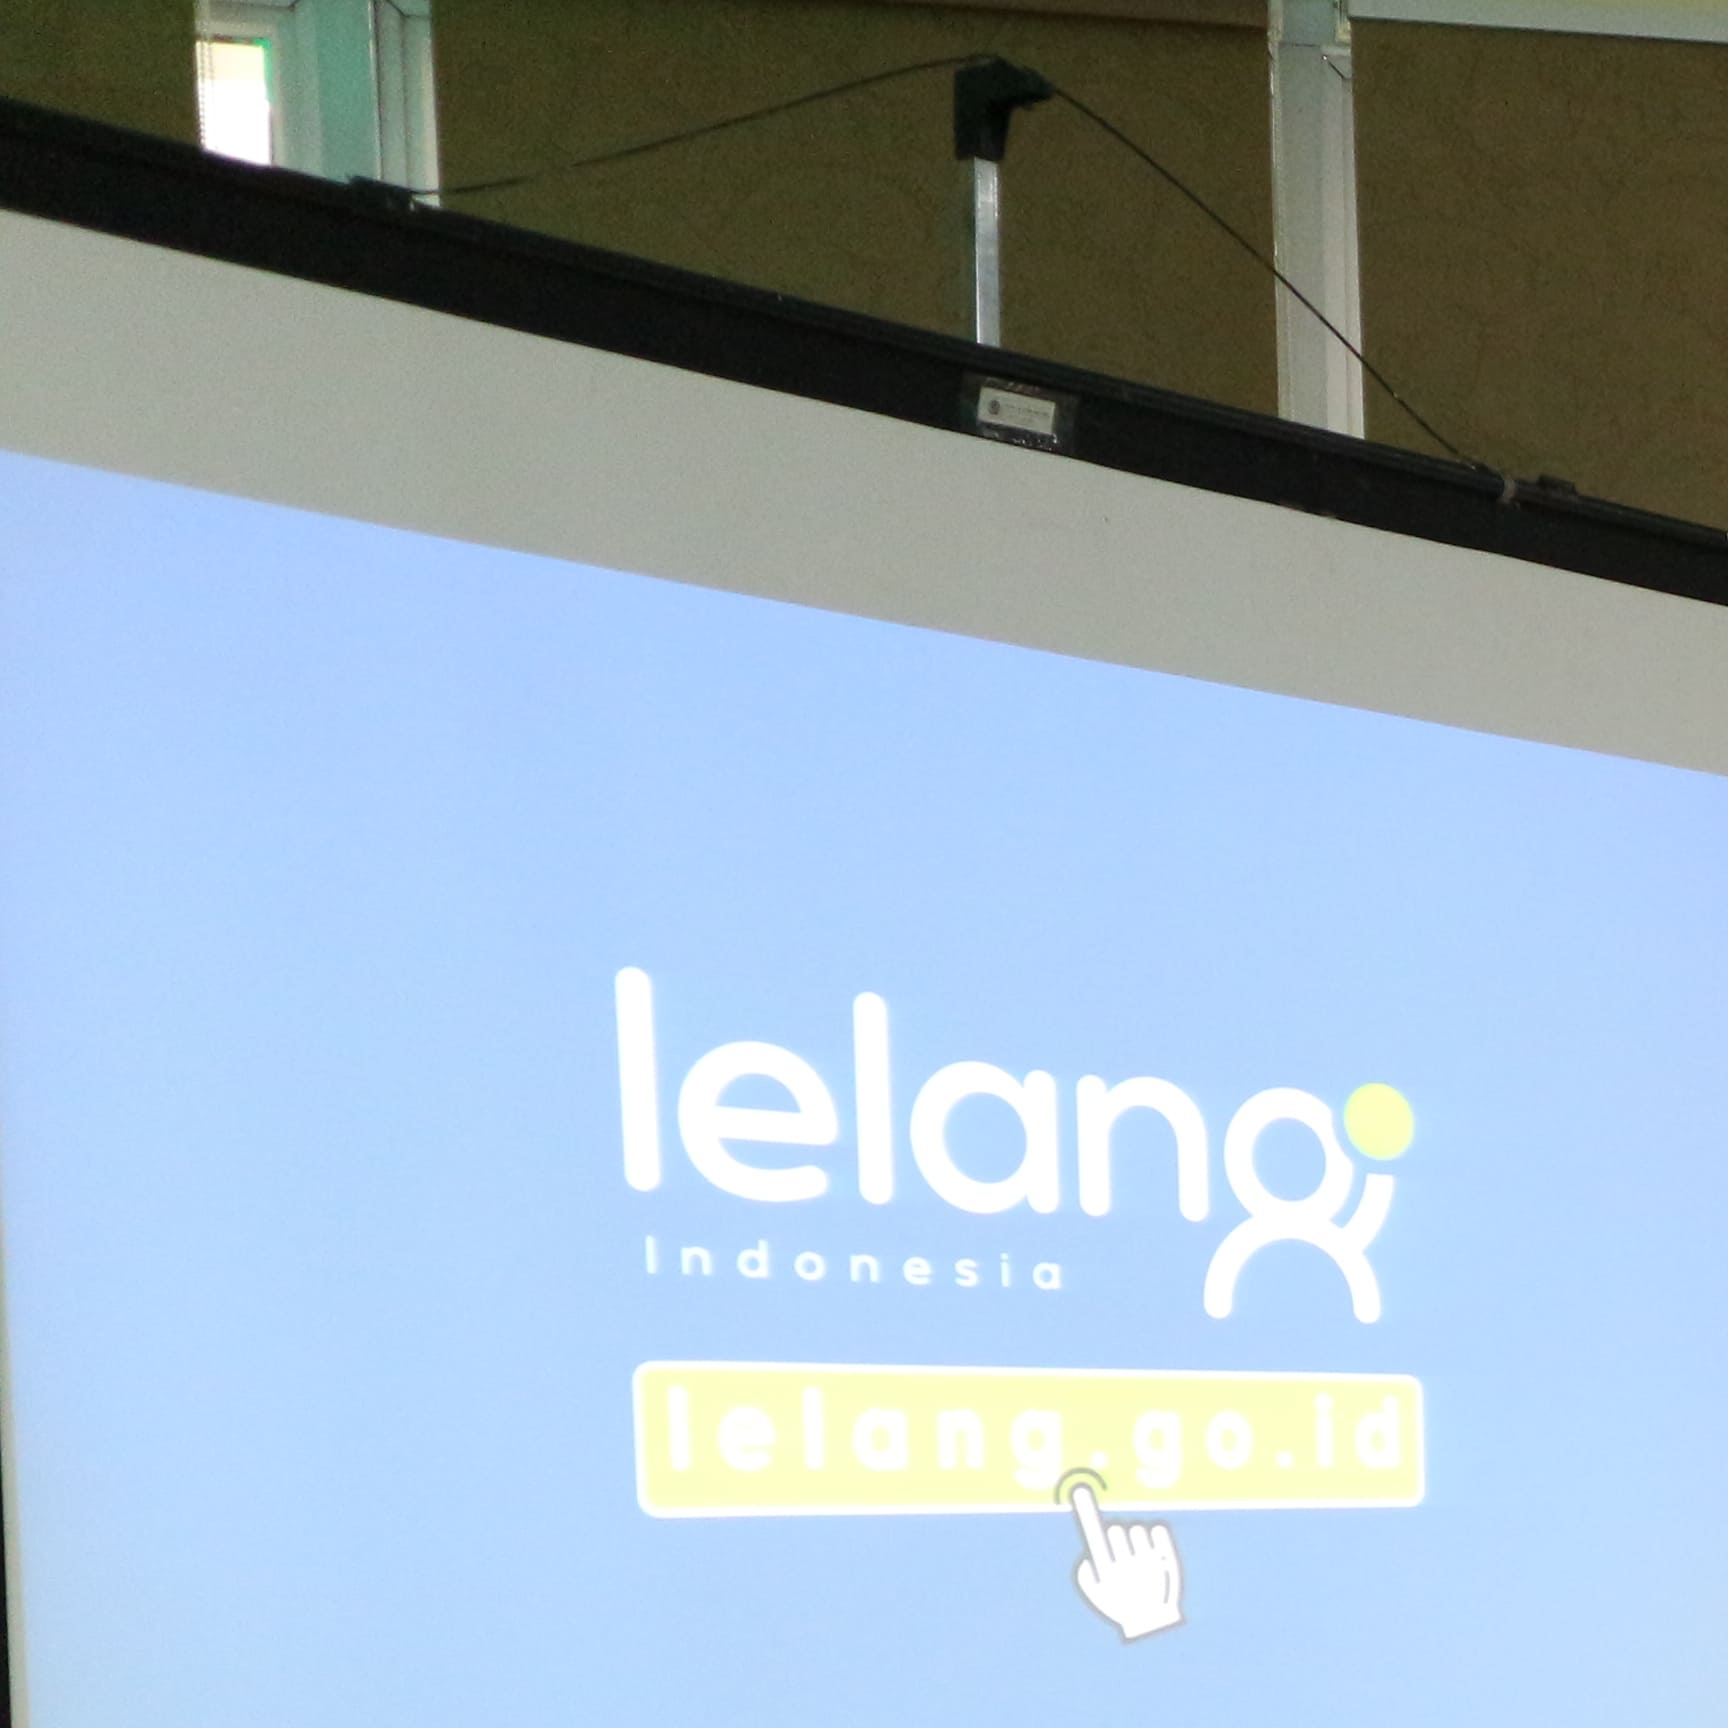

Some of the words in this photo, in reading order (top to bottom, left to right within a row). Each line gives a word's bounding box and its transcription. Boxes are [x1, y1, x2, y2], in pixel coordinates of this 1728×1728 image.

[613, 965, 1415, 1324] lelang
[644, 1235, 1065, 1293] Indonesia
[664, 1383, 1402, 1490] lelang.go.id
